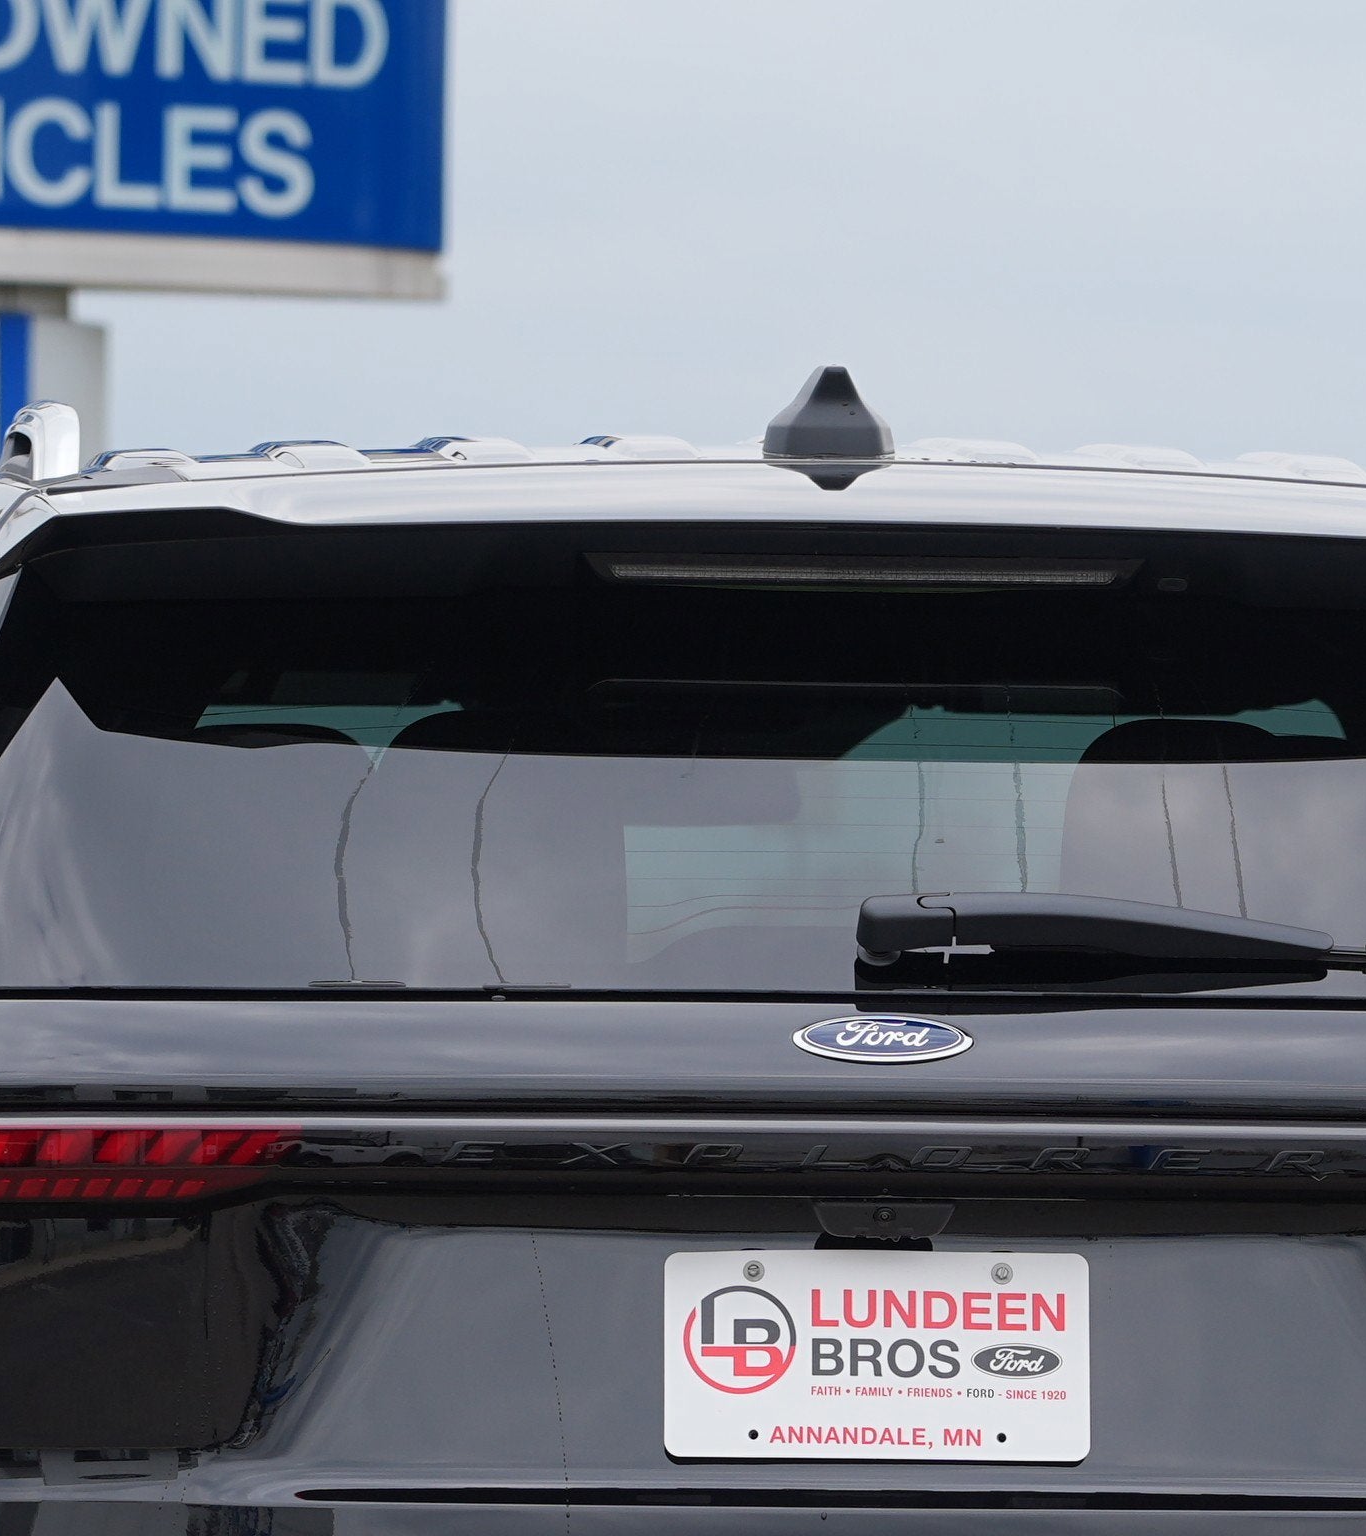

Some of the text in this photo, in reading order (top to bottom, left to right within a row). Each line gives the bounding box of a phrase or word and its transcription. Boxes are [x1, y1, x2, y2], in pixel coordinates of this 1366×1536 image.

[835, 1020, 931, 1048] Ford
[441, 1140, 1325, 1173] EXPLORER
[811, 1288, 1066, 1332] LUNDEEN
[811, 1337, 961, 1379] BROS
[988, 1347, 1046, 1375] Ford
[811, 1386, 841, 1396] FAITH
[855, 1386, 893, 1397] FAMILY
[907, 1387, 953, 1398] FRIENDS
[966, 1388, 995, 1399] FORD
[1006, 1389, 1037, 1400] SINCE
[1041, 1390, 1067, 1400] 1920
[769, 1425, 982, 1450] ANNANDALE, MN
